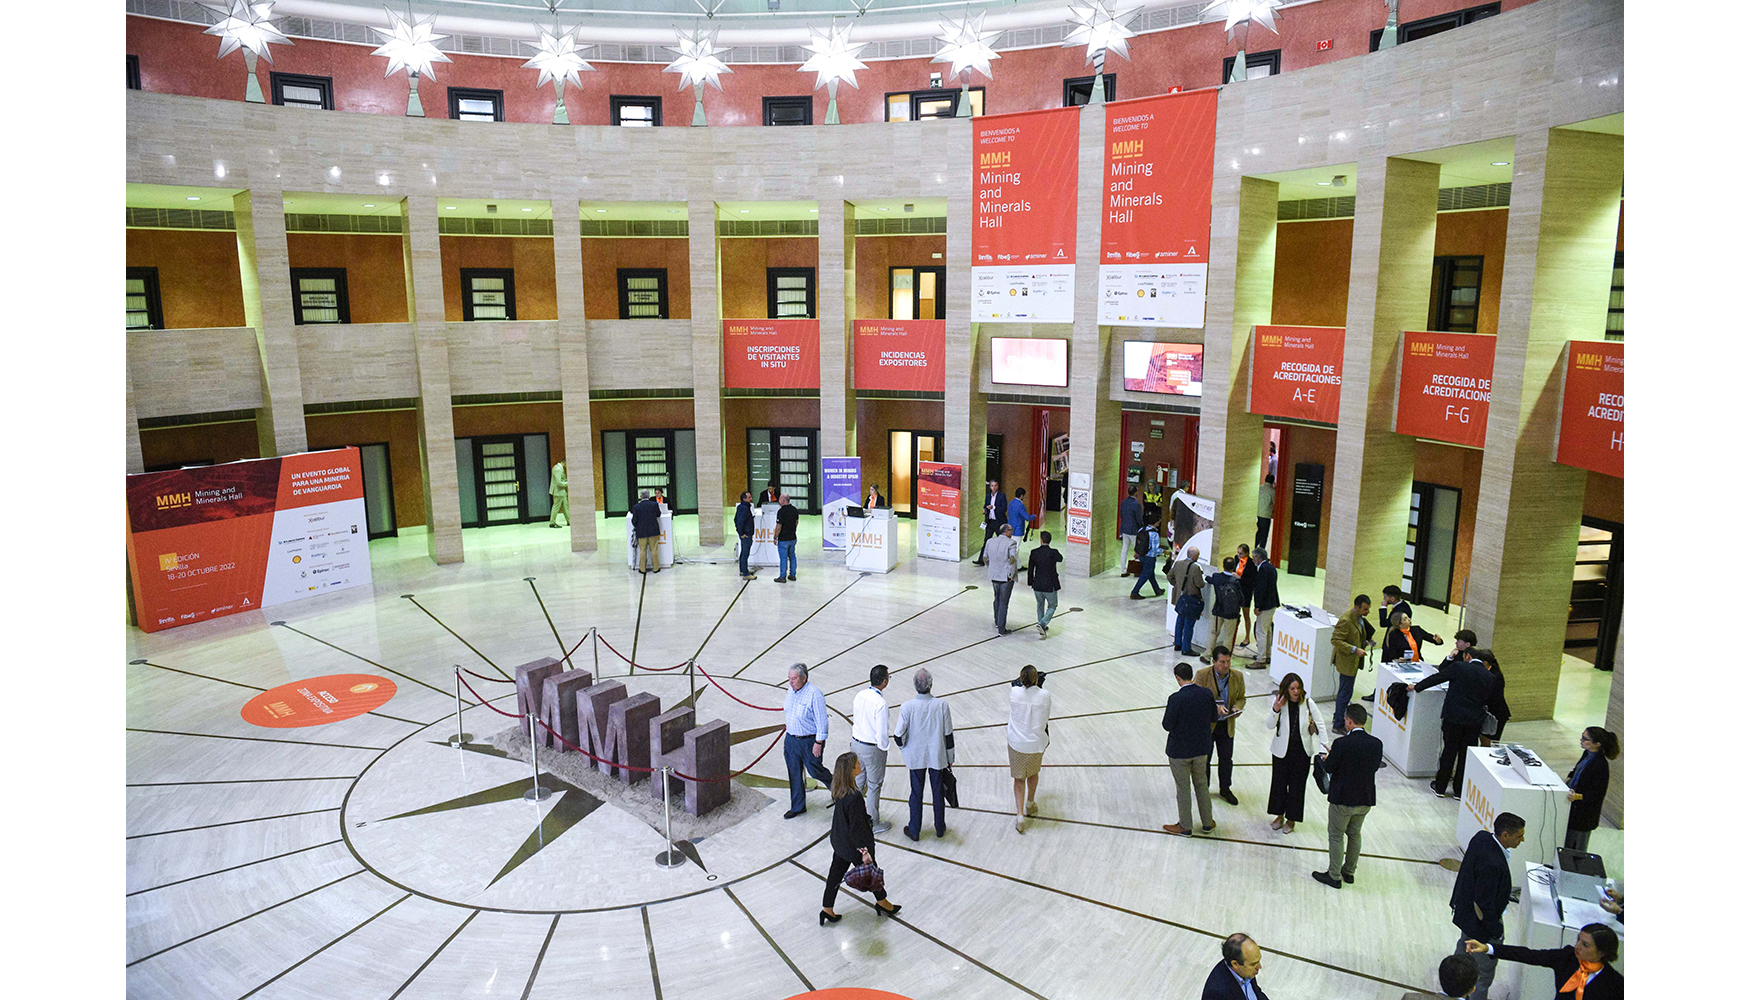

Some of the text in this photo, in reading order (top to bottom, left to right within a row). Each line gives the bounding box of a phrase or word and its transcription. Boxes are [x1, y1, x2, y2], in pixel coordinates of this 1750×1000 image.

[1113, 114, 1149, 125] BIENVENIDOS
[980, 128, 1016, 138] BIENVENIDOS
[1113, 124, 1141, 133] WELCOME
[980, 136, 1007, 144] WELCOME
[1112, 140, 1144, 156] MMH
[980, 152, 1011, 166] MMH
[1111, 162, 1154, 177] Mining
[980, 171, 1021, 186] Mining
[1110, 178, 1133, 193] and
[980, 187, 1002, 200] and
[1110, 192, 1163, 208] Minerals
[980, 200, 1031, 214] Minerals
[980, 216, 1003, 229] Hall
[1110, 210, 1134, 224] Hall
[1262, 334, 1282, 344] MMH
[1284, 335, 1301, 344] Mining
[1410, 342, 1434, 354] MMH
[1436, 344, 1454, 352] Mining
[1436, 350, 1458, 358] Minerals
[881, 351, 925, 359] INCIDENCIAS
[1576, 353, 1602, 366] MMH
[879, 359, 928, 367] EXPOSITORES
[1281, 361, 1335, 374] RECOGIDA DE
[1272, 371, 1341, 385] ACREDITACIONES
[1432, 374, 1490, 390] RECOGIDA DE
[1292, 387, 1316, 404] A-E
[1598, 392, 1624, 407] RECO
[1446, 404, 1469, 423] F-G
[1588, 406, 1624, 422] ACREDI
[302, 470, 326, 479] EVENTO
[327, 466, 350, 476] GLOBAL
[292, 479, 309, 487] PARA
[303, 483, 342, 495] VANGUARDIA
[195, 488, 220, 498] Mining
[195, 494, 227, 505] Minerals
[156, 492, 191, 508] MMH
[755, 528, 775, 539] MH
[851, 532, 882, 546] MMH
[173, 552, 200, 564] EDICIÓN
[166, 563, 189, 572] Sevilla
[167, 562, 236, 580] 18-20 OCTUBRE 2022
[1278, 630, 1310, 660] MMH
[269, 701, 296, 718] MMH
[515, 656, 730, 818] MMH
[1466, 778, 1494, 828] MMH
